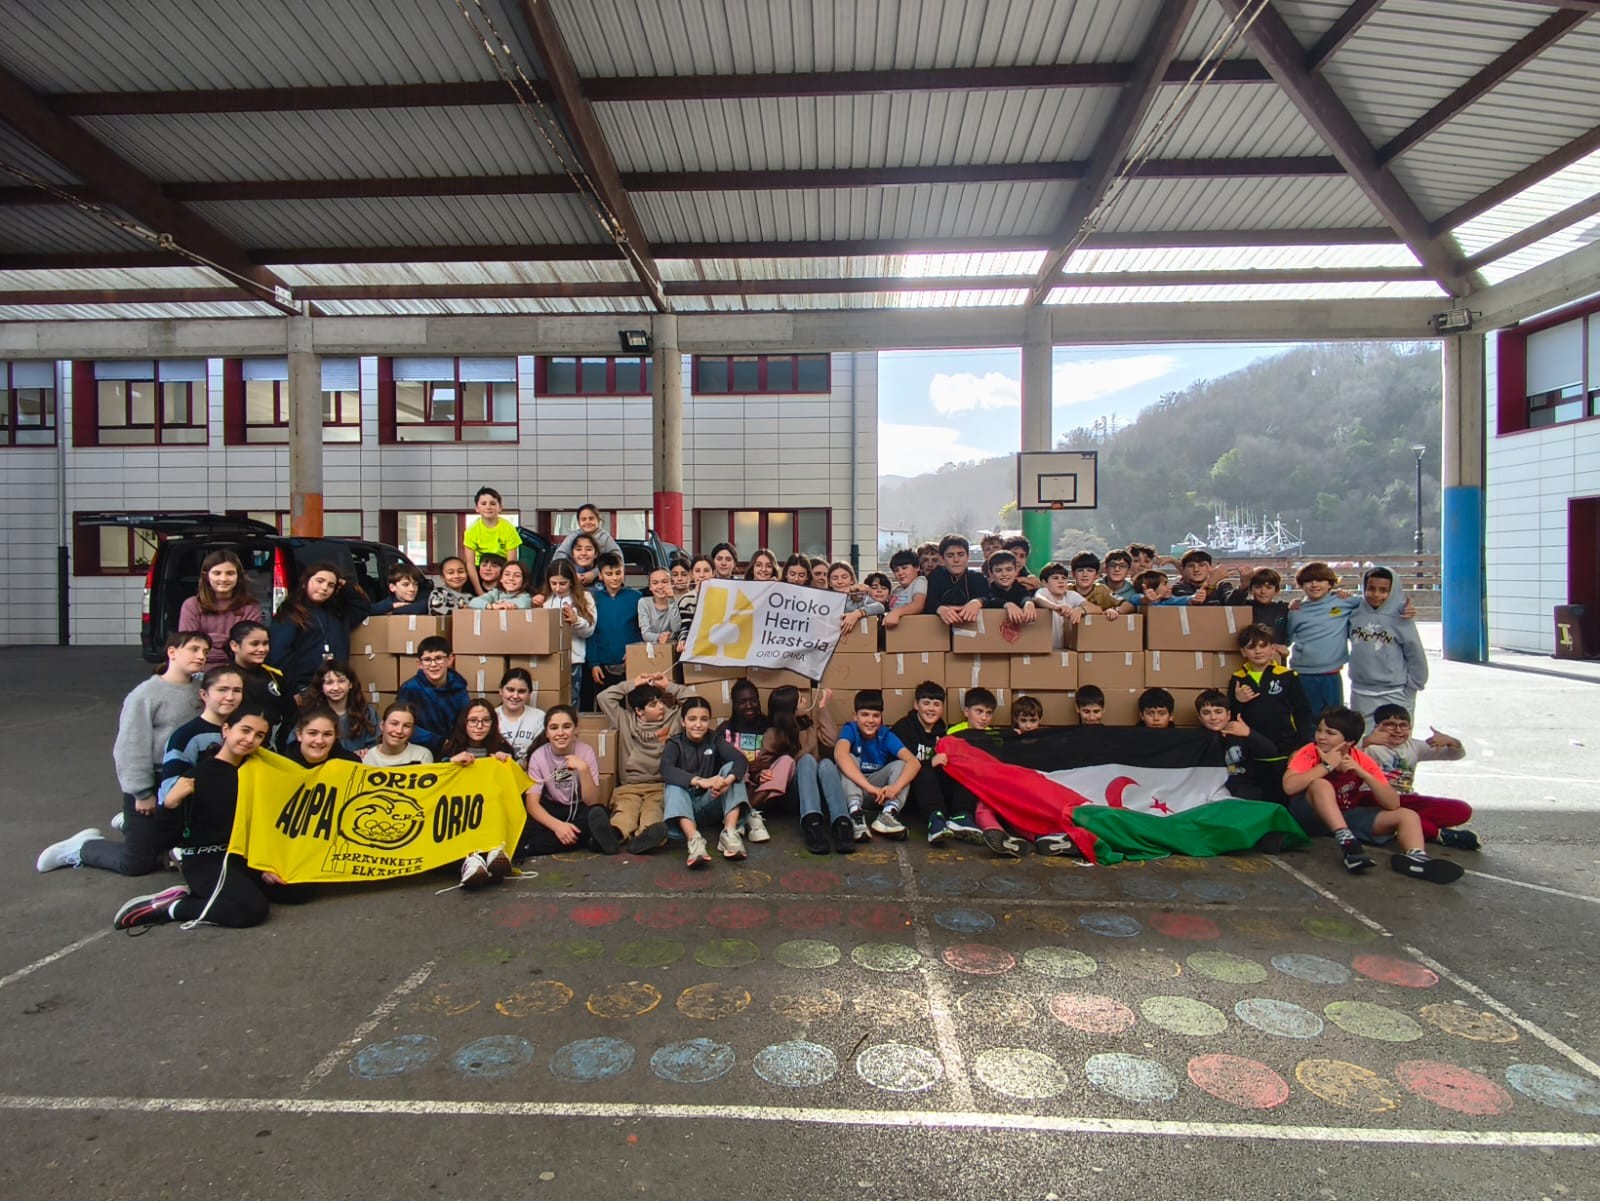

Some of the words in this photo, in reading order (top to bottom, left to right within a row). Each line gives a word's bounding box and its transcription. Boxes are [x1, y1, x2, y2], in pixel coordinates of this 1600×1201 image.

[768, 592, 830, 616] Orioko
[765, 610, 810, 632] Herri
[761, 630, 829, 653] Ikastola
[756, 650, 780, 658] ORIO
[275, 782, 338, 841] AUPA
[432, 793, 484, 843] ORIO
[351, 865, 422, 876] ELKARTEA
